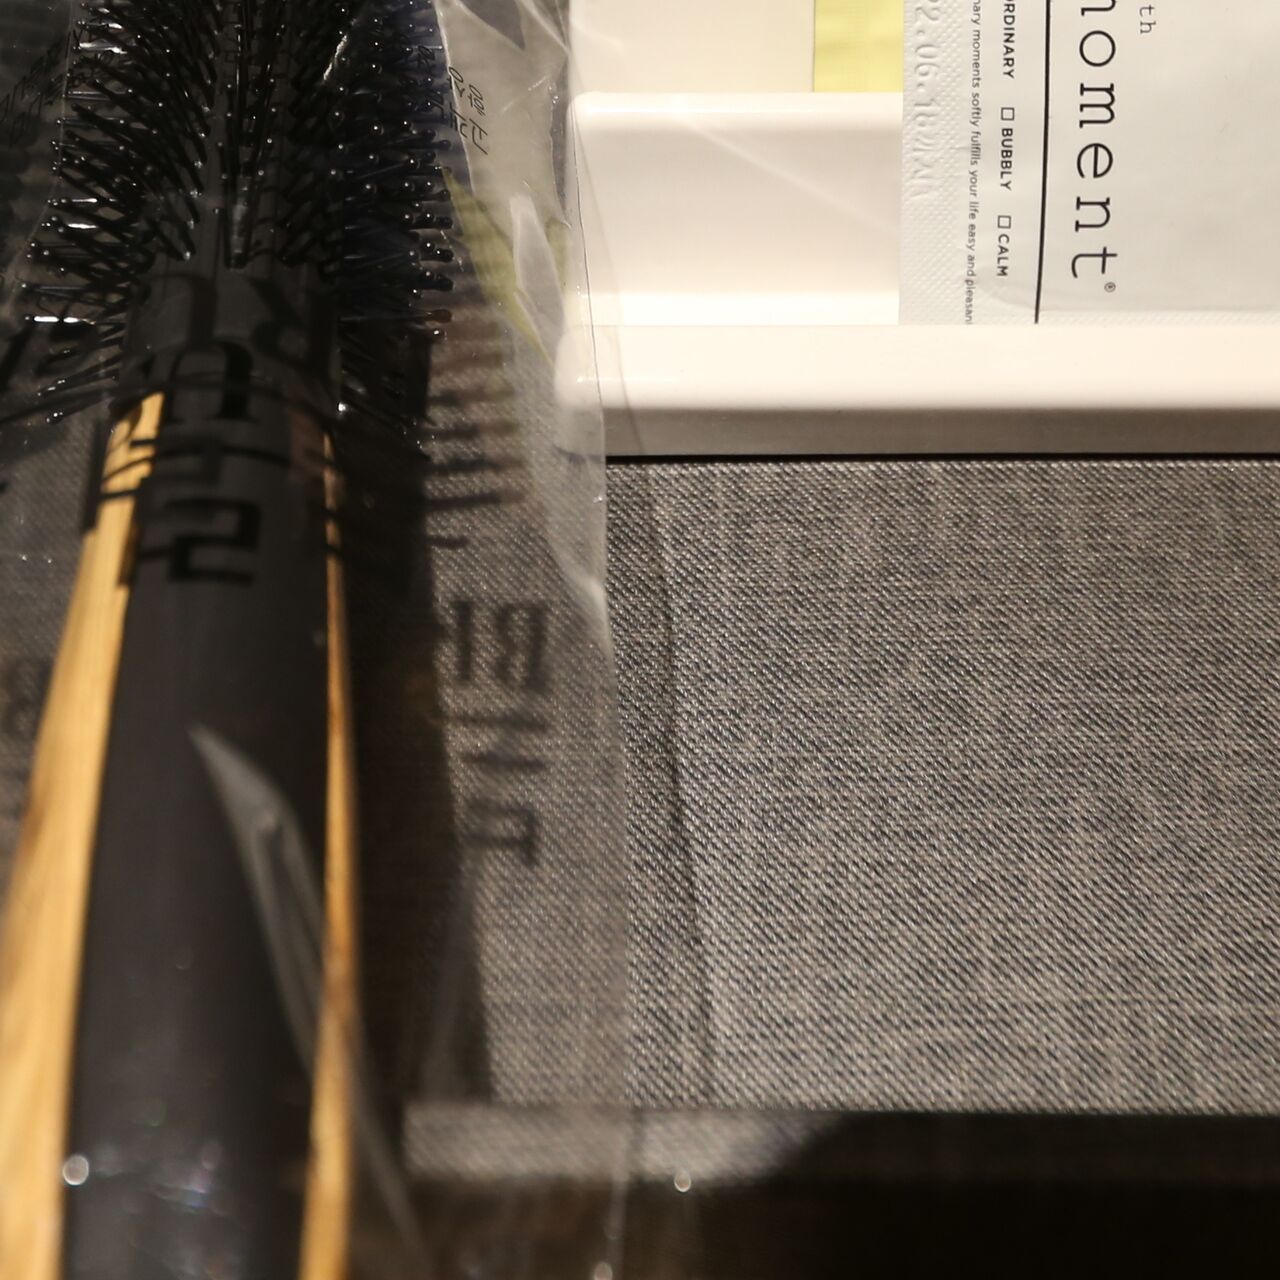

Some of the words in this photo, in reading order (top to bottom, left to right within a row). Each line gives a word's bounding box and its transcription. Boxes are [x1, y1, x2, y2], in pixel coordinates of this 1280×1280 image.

[971, 29, 983, 89] moments
[968, 91, 982, 128] softly
[969, 130, 982, 166] fulfills
[999, 127, 1015, 192] BUBBLY
[967, 169, 980, 197] your
[967, 200, 981, 220] life
[964, 223, 978, 251] easy
[965, 254, 978, 277] and
[996, 233, 1011, 278] CALM
